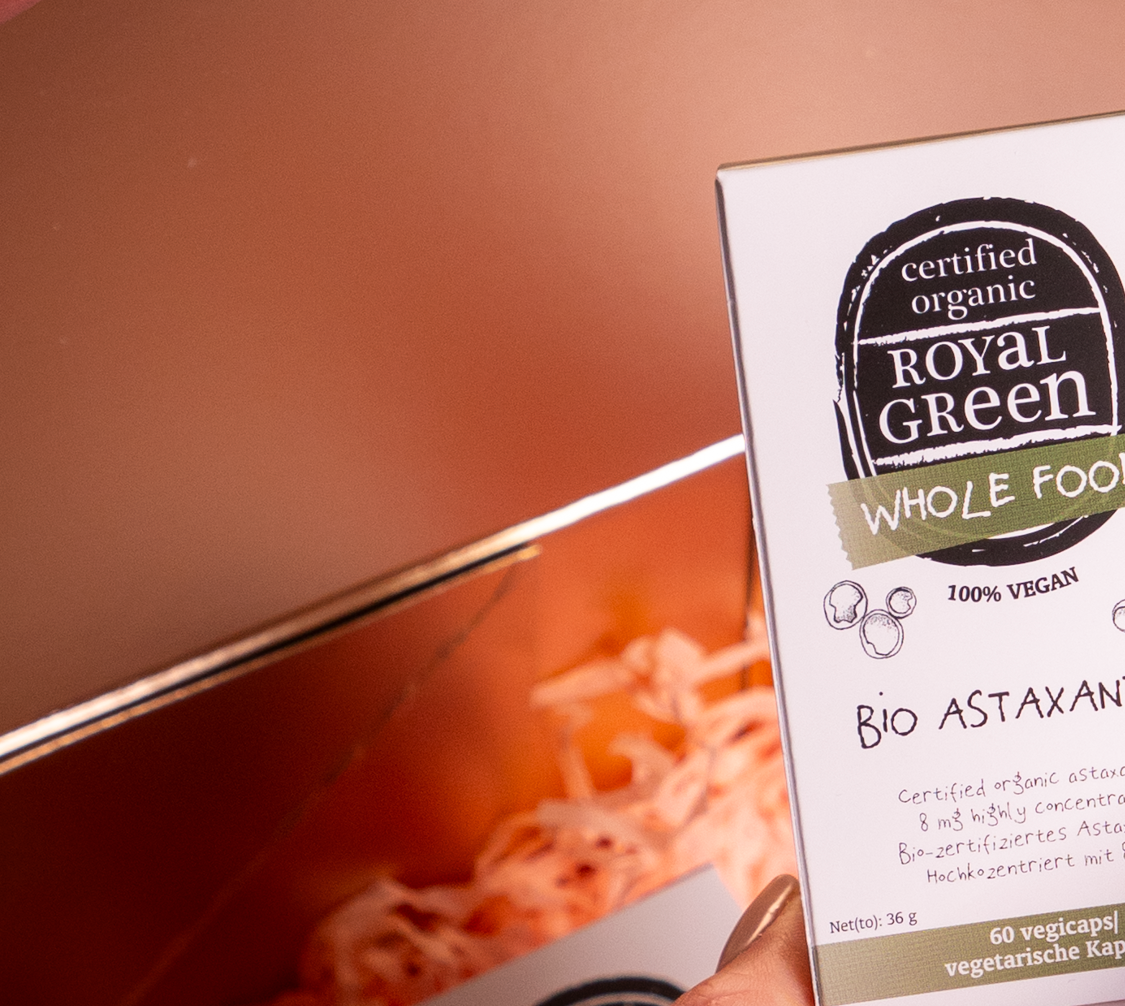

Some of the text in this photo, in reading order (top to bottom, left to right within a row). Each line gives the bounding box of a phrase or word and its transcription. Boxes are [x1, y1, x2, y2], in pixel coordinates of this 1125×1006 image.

[901, 239, 1037, 282] certified
[911, 275, 1036, 320] organic
[860, 471, 1016, 535] WHOLE
[947, 566, 1080, 603] 100% VEGAN
[898, 779, 986, 805] Certified
[993, 771, 1059, 796] organic
[919, 813, 930, 832] 8
[937, 807, 964, 832] mg
[971, 803, 1027, 826] highly
[898, 826, 1067, 865] Bio-zertifiziertes
[1083, 848, 1115, 867] mit
[829, 911, 918, 936] Net(to): 36 g
[989, 925, 1014, 946] 60
[944, 946, 1080, 978] vegetarische
